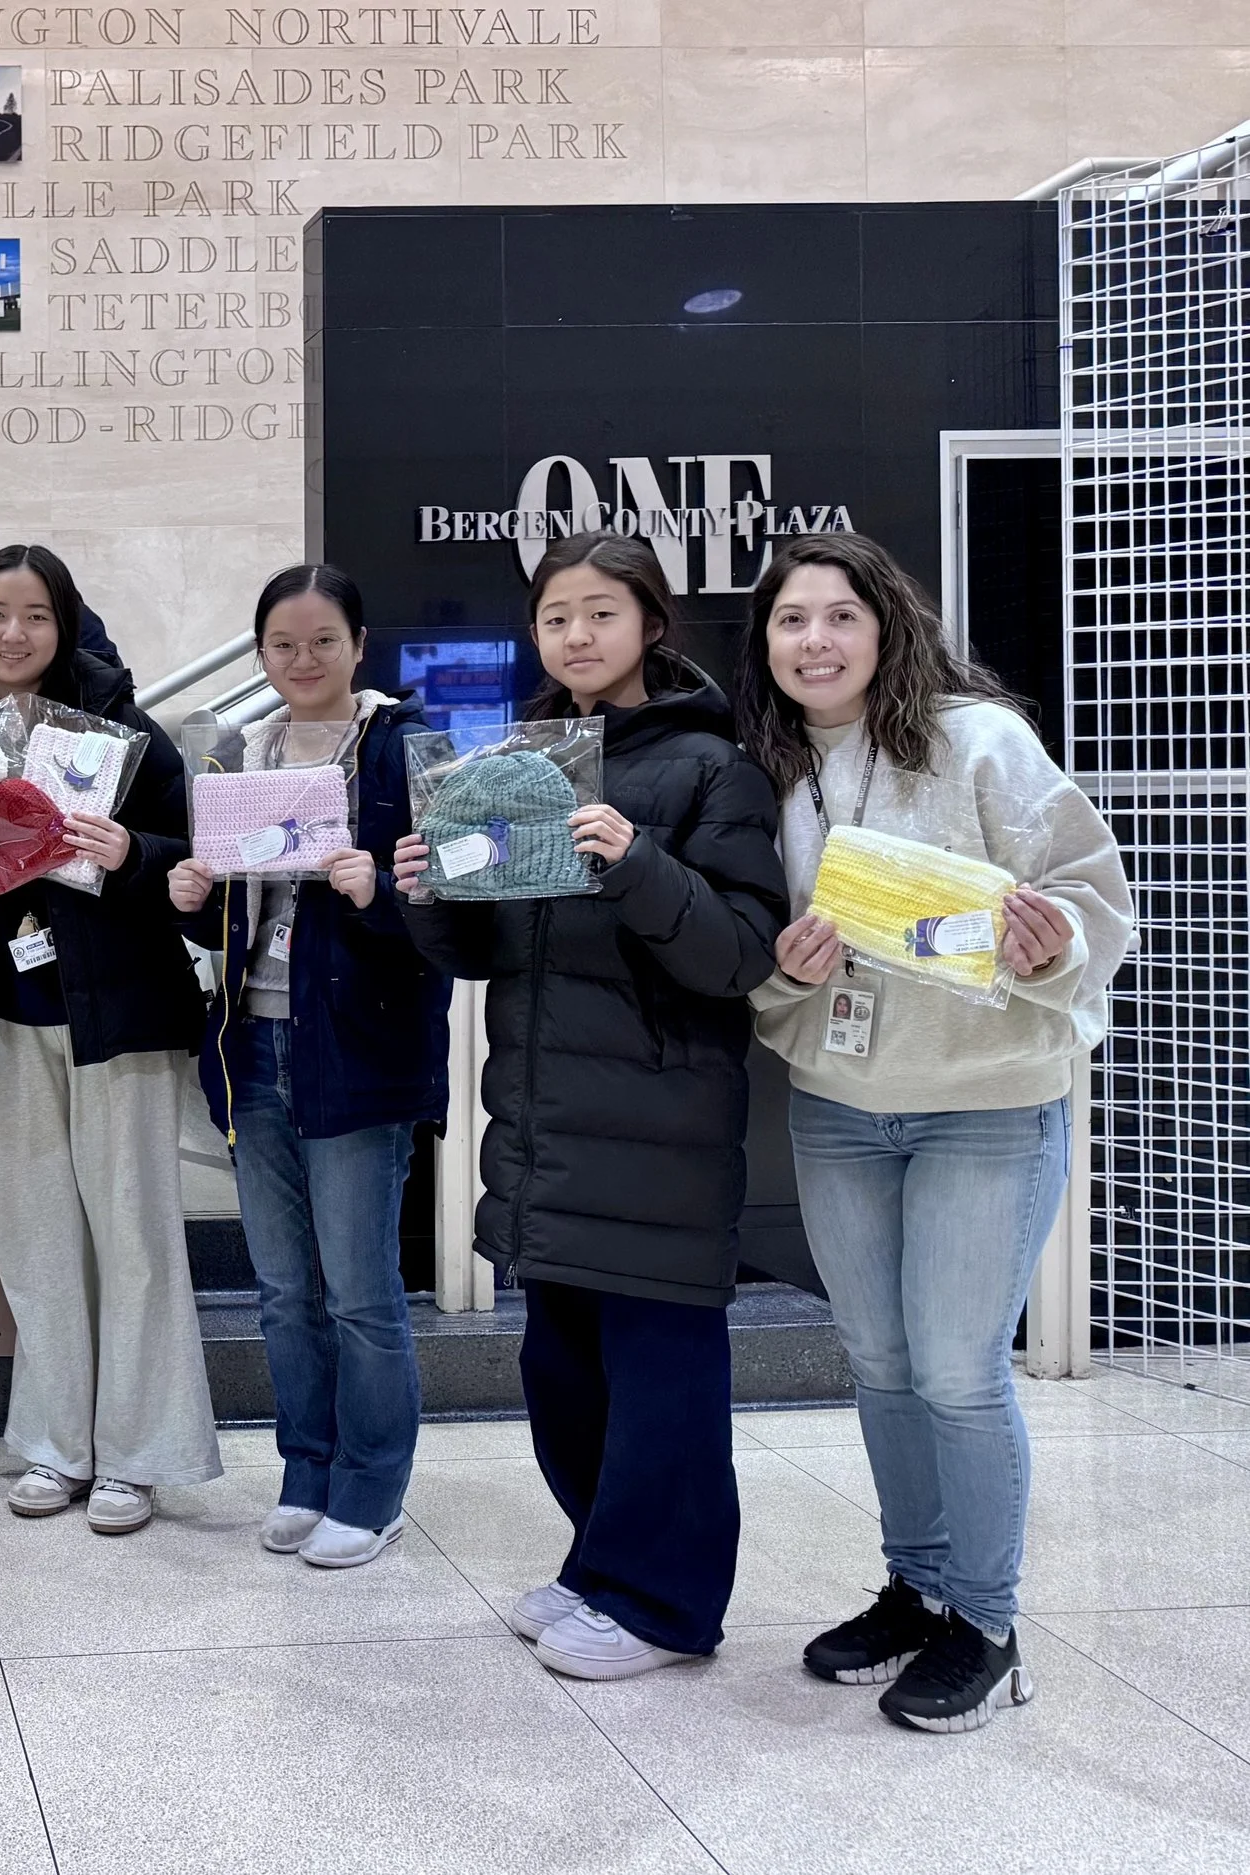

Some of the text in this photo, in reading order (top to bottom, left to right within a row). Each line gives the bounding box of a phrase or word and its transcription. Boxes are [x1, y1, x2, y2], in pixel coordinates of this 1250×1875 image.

[225, 8, 600, 45] NORTHVALE
[51, 68, 386, 106] PALISADES
[414, 69, 573, 104] PARK
[51, 124, 442, 162] RIDGEFIELD
[467, 123, 628, 159] PARK
[143, 179, 304, 220] PARK
[50, 236, 300, 275] SADDLE
[50, 292, 304, 331] TETERB
[419, 499, 856, 543] BERGEN COUNTY PLAZA
[515, 455, 772, 595] ONE
[865, 746, 876, 777] COUNTY
